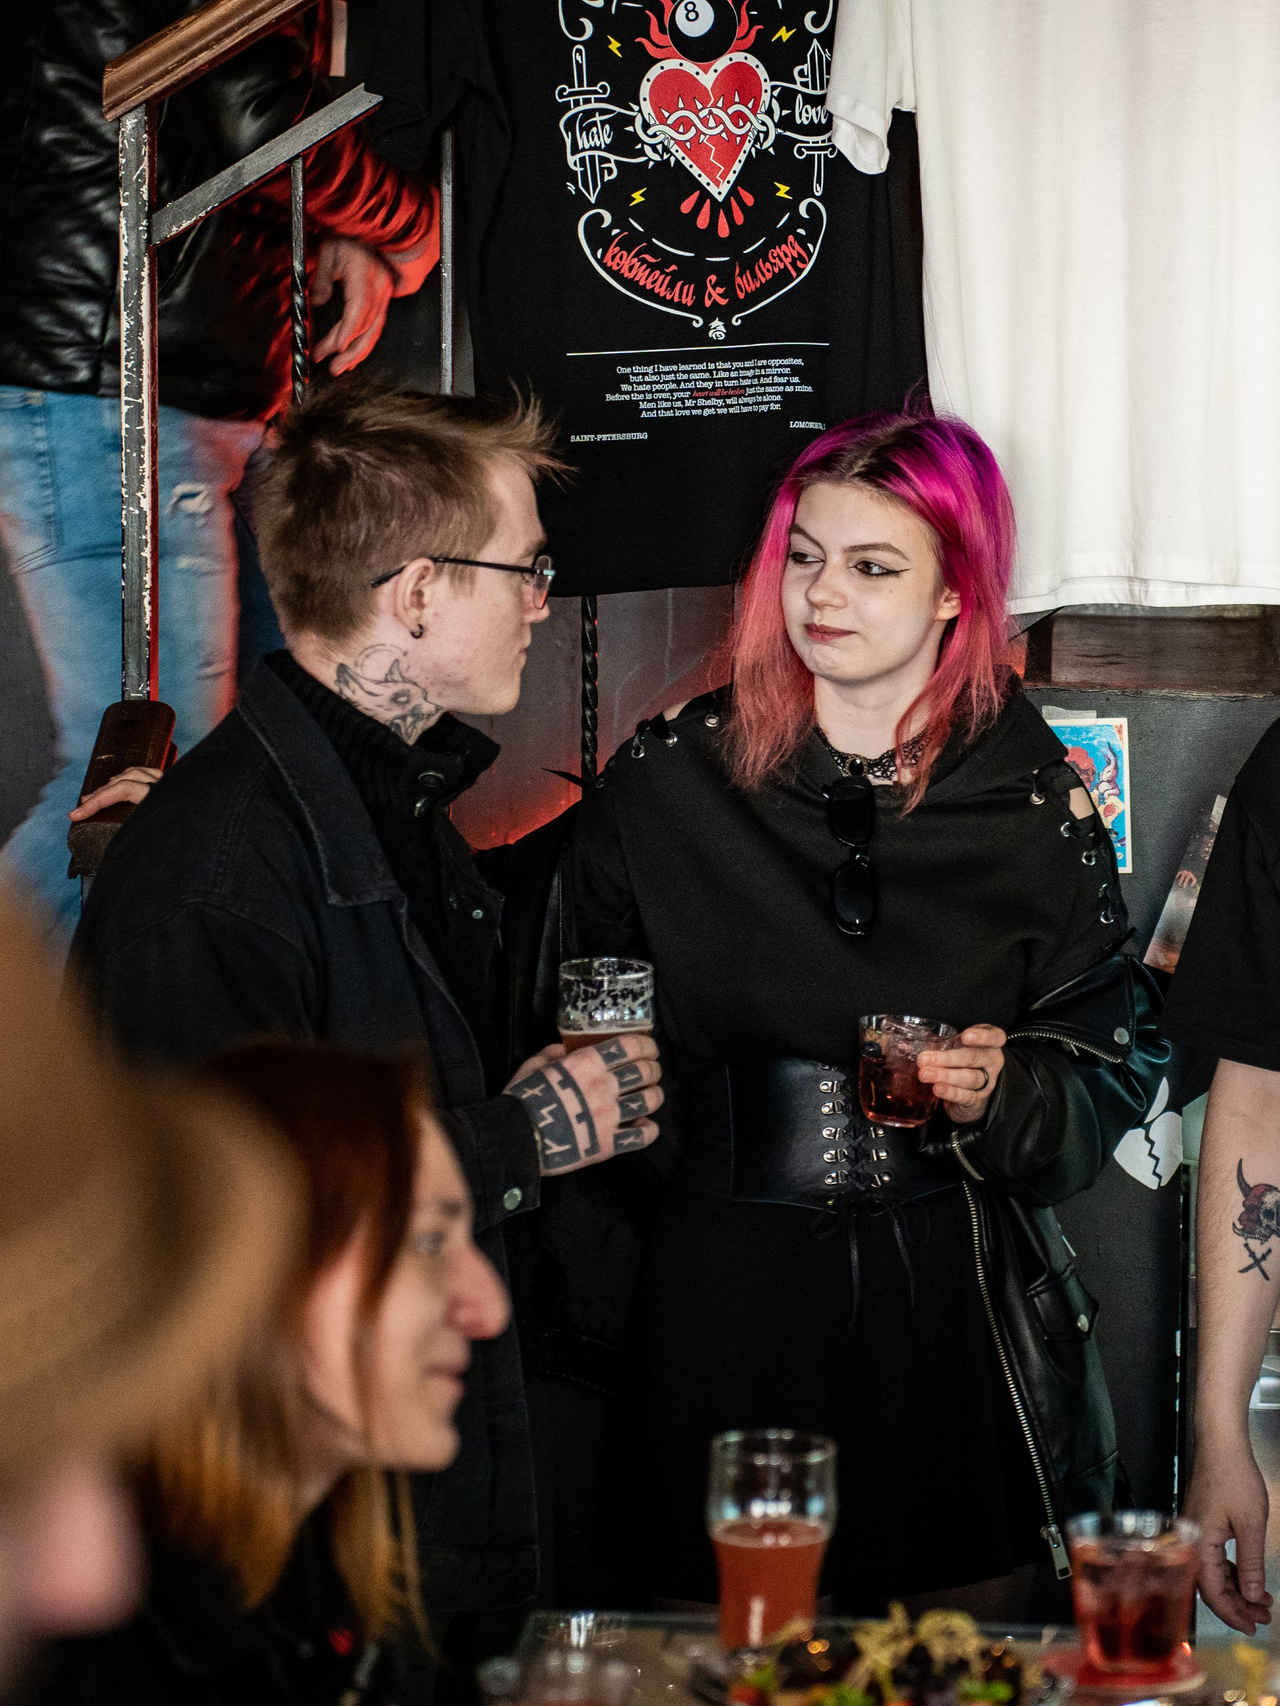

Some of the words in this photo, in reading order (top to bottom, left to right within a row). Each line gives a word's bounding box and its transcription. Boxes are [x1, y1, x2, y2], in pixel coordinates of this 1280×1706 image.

[684, 2, 699, 23] 8
[795, 93, 829, 125] love
[575, 111, 618, 150] hate
[602, 232, 696, 307] коктейли
[704, 274, 729, 308] &
[734, 234, 810, 299] бильярд
[616, 366, 631, 374] One
[632, 365, 654, 374] thing
[659, 364, 677, 372] have
[678, 362, 707, 370] learned
[768, 358, 804, 366] opposites,
[644, 374, 660, 382] also
[660, 373, 676, 382] just
[676, 372, 688, 380] the
[713, 370, 729, 378] Like
[766, 367, 791, 375] mirror.
[620, 384, 632, 392] We
[633, 383, 651, 391] hate
[652, 382, 678, 392] people.
[696, 380, 714, 389] they
[715, 380, 723, 388] in
[739, 378, 751, 386] hate
[759, 376, 772, 384] And
[653, 392, 672, 400] over,
[673, 391, 691, 400] your
[745, 387, 756, 396] just
[697, 398, 725, 406] Shelby,
[725, 397, 738, 405] will
[739, 396, 756, 404] always
[641, 410, 657, 418] And
[703, 408, 716, 416] get
[570, 432, 648, 442] SAINT-PETERSBURG
